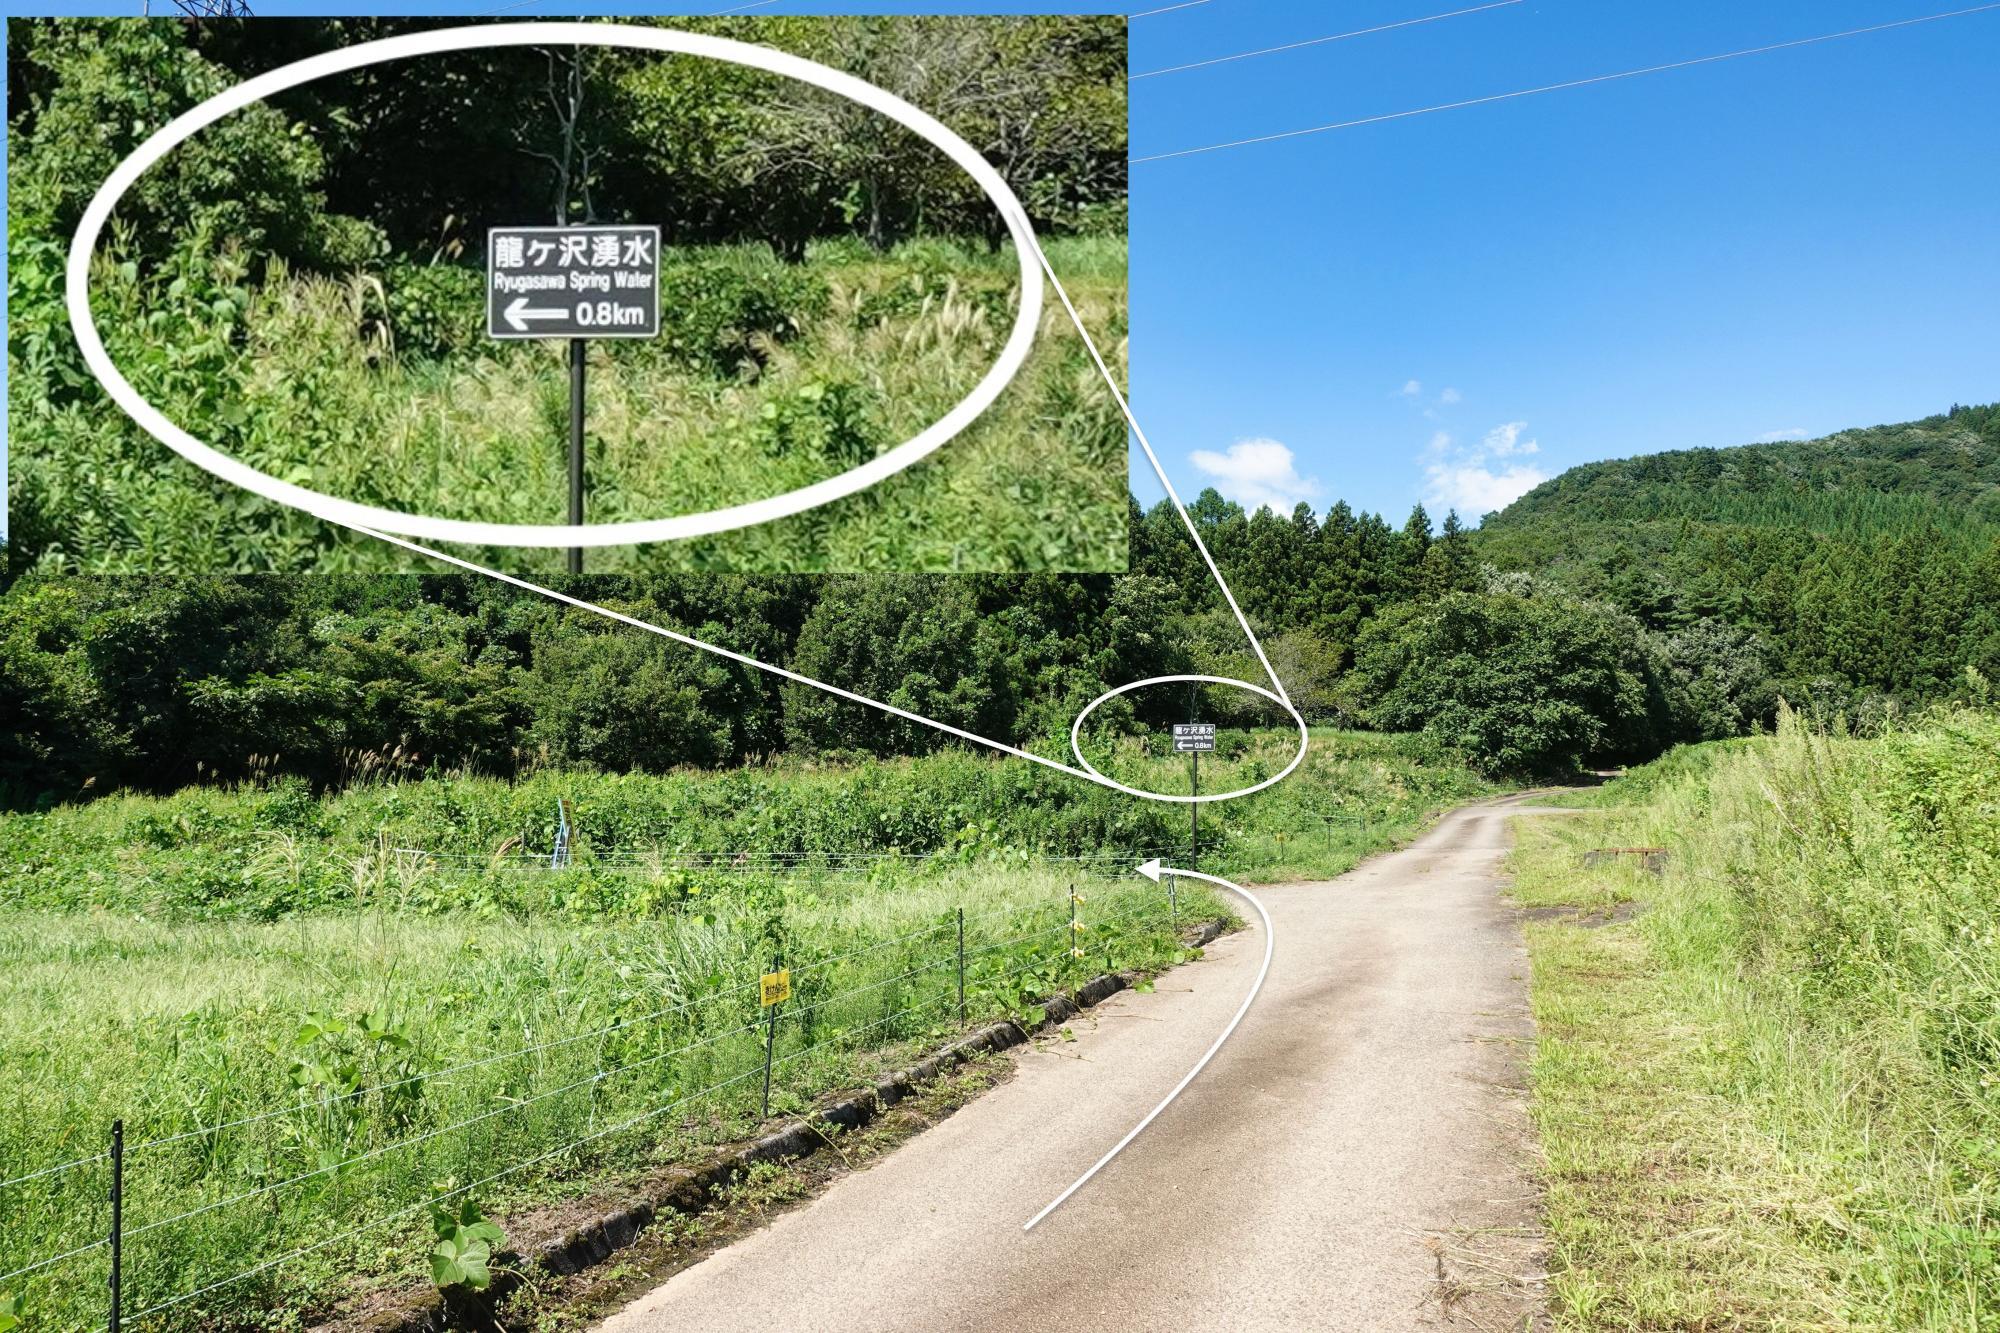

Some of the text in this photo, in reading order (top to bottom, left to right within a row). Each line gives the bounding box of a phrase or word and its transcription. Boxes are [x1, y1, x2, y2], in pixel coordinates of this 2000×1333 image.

[494, 271, 653, 293] Ryugasawa Spring Water
[576, 302, 644, 326] 0.8km
